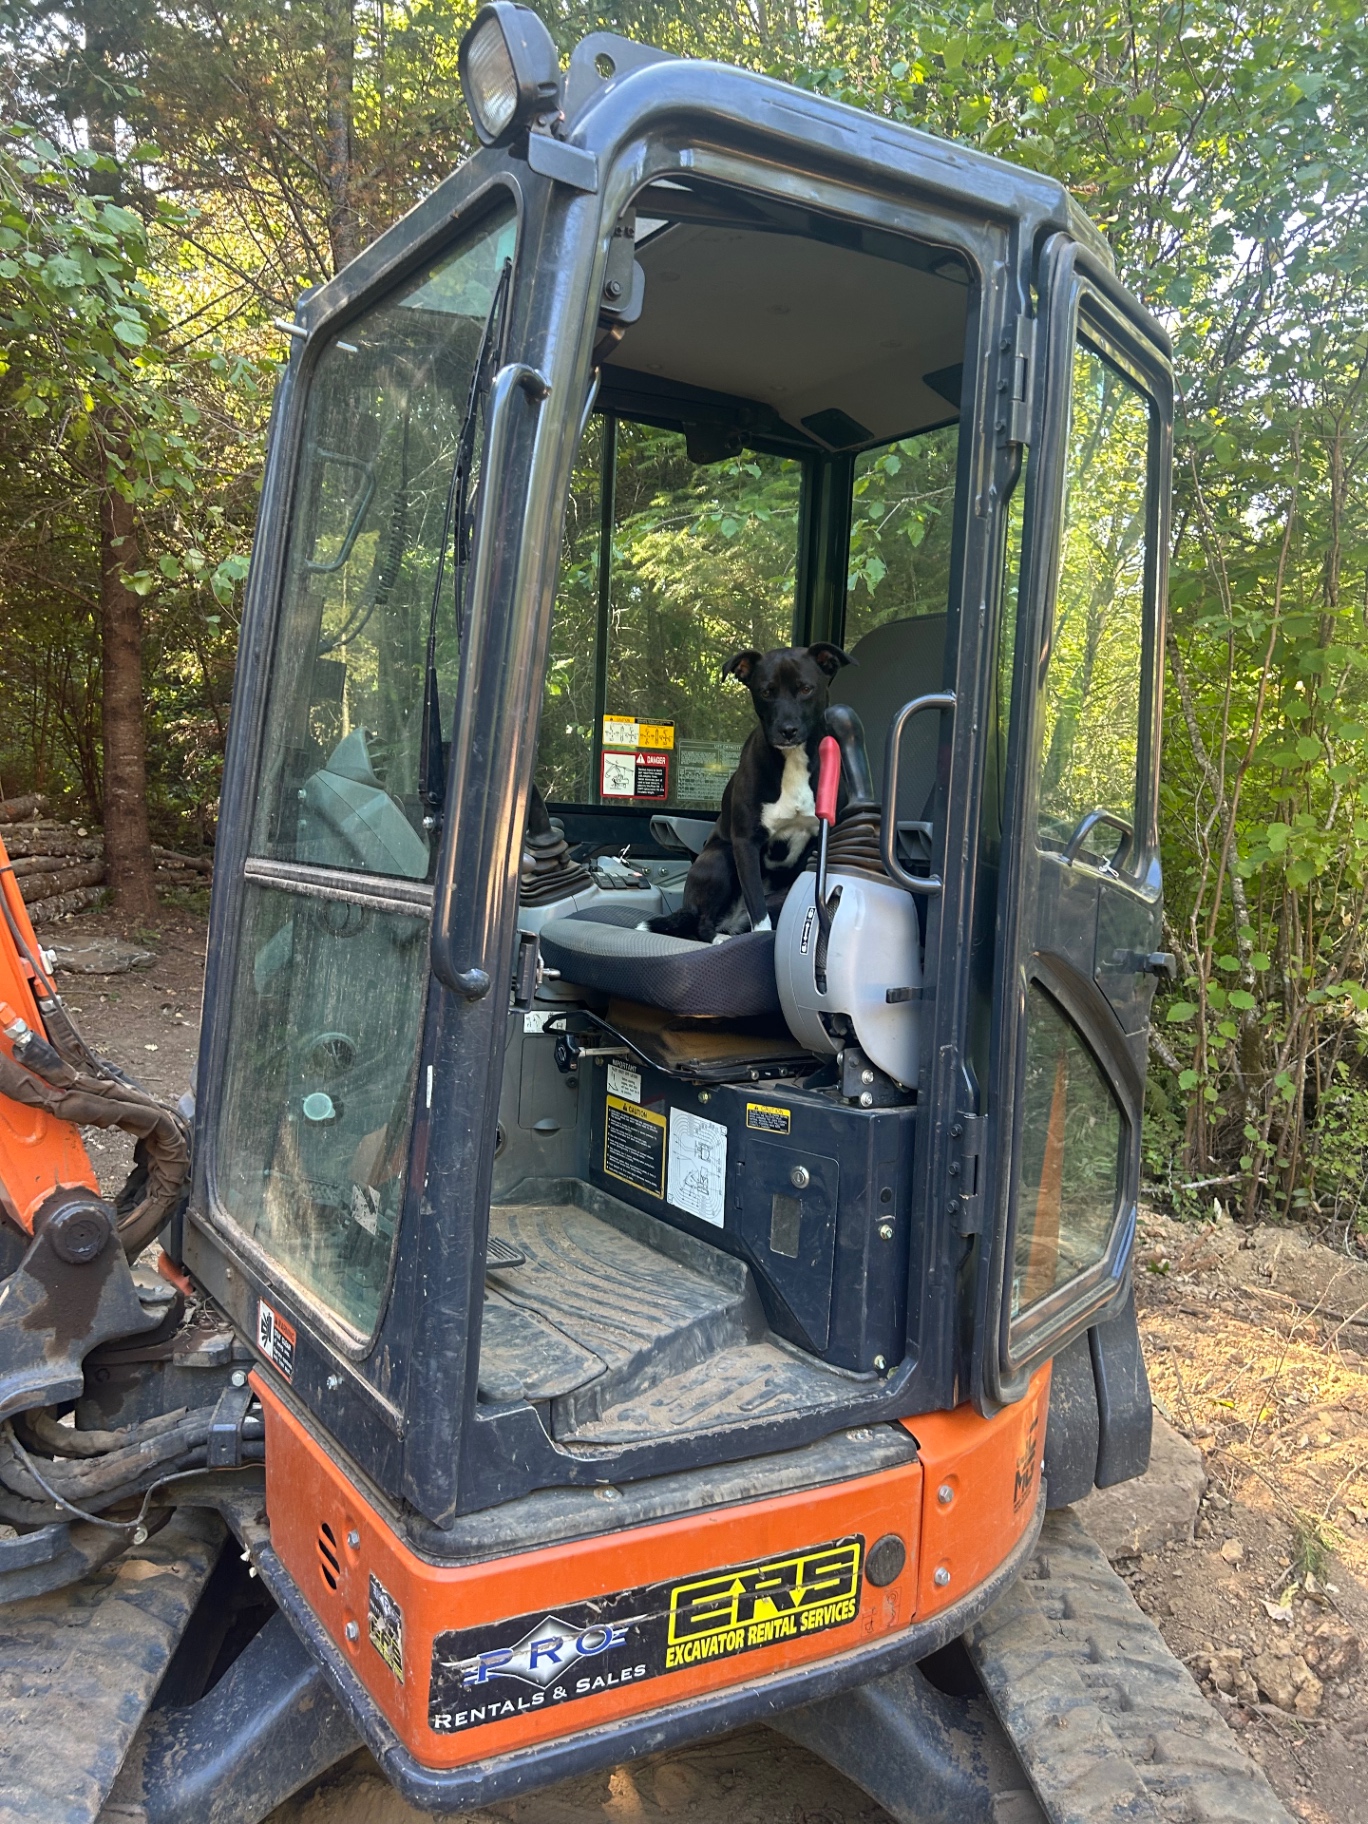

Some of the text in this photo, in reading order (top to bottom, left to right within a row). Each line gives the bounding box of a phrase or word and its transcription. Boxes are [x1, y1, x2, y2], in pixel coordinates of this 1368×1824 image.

[646, 755, 666, 765] DANGER
[628, 1104, 648, 1119] CAUTION
[673, 1547, 856, 1640] ERS
[474, 1624, 613, 1684] PRO
[665, 1598, 856, 1669] EXCAVATOR RENTAL SERVICES
[434, 1664, 646, 1730] RENTALS & SALES
